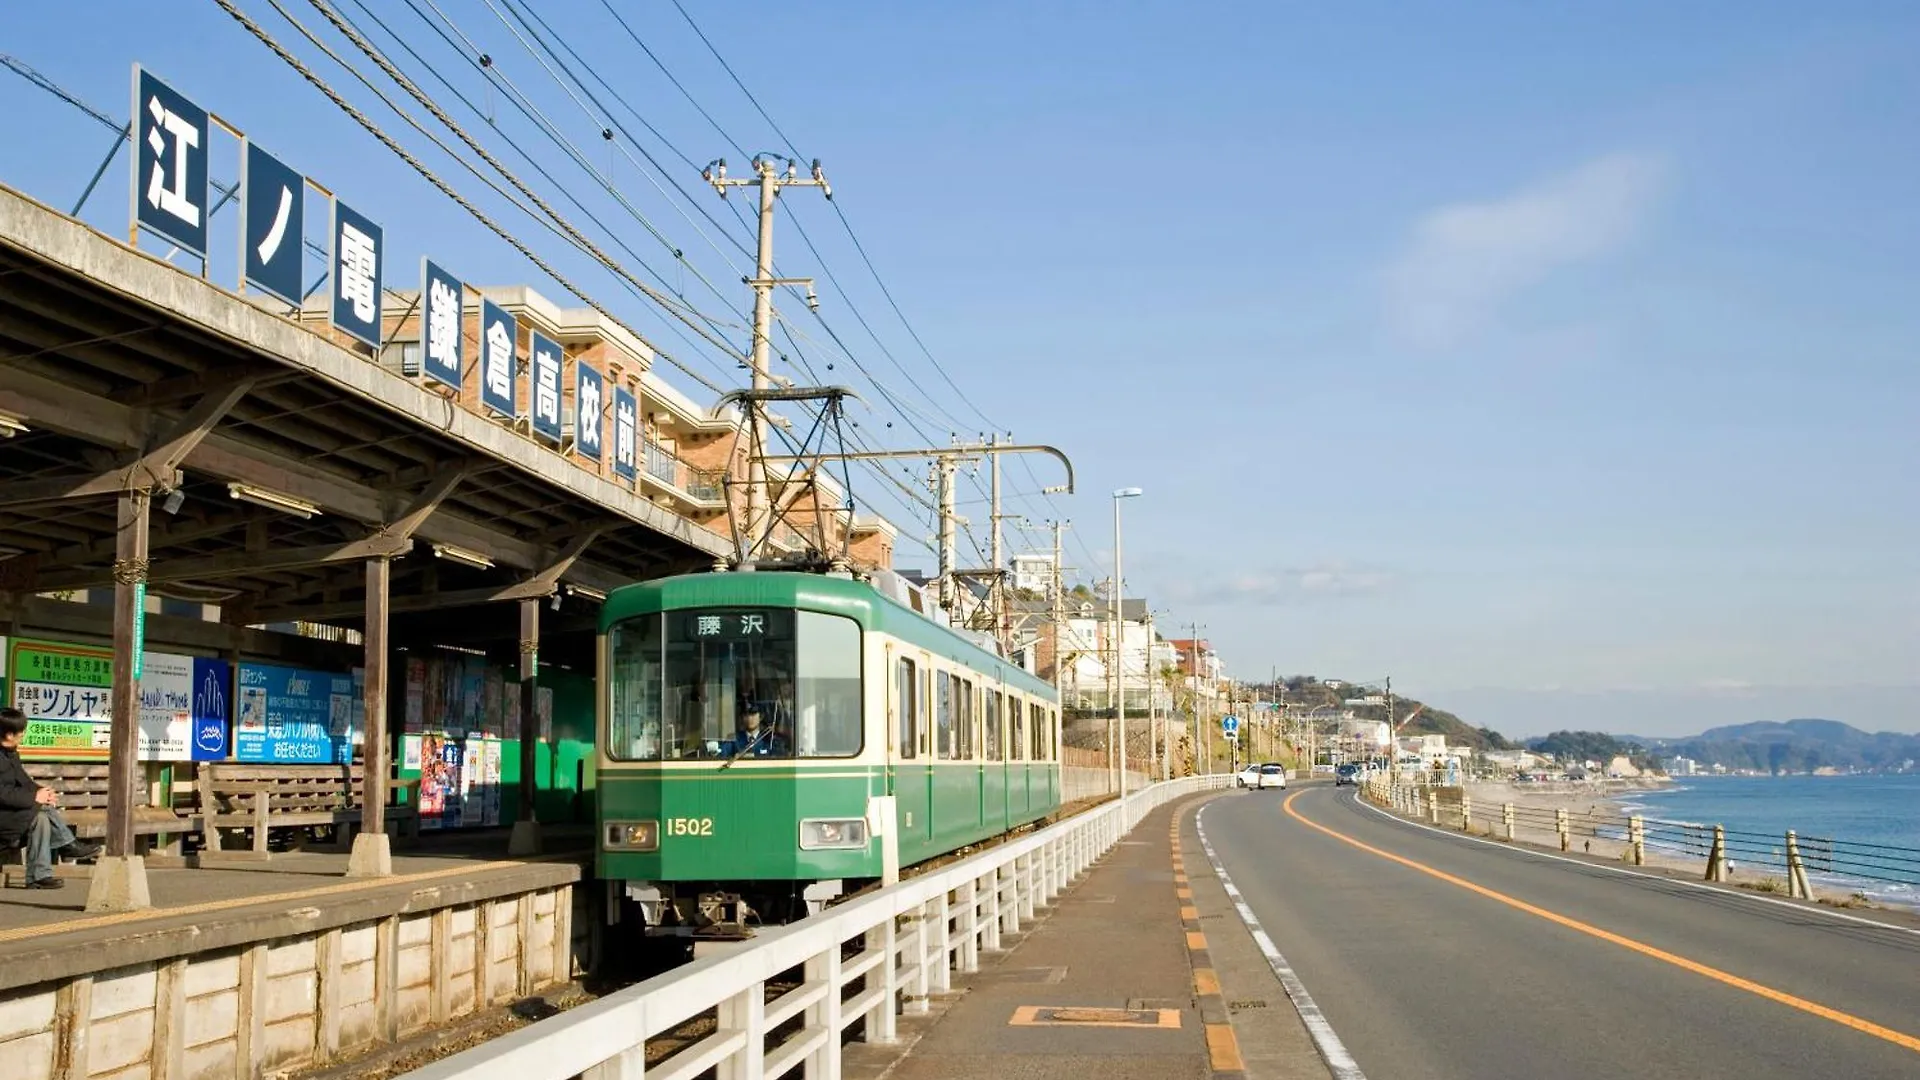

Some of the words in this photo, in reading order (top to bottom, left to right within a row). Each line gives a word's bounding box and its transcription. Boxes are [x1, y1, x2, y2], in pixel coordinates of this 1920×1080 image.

[148, 95, 376, 323] 江ノ電
[429, 278, 634, 466] 鎌倉高校前
[697, 615, 764, 634] 藤沢
[42, 688, 98, 717] ツルヤ
[274, 742, 321, 758] お任せください
[667, 818, 713, 837] 1502
